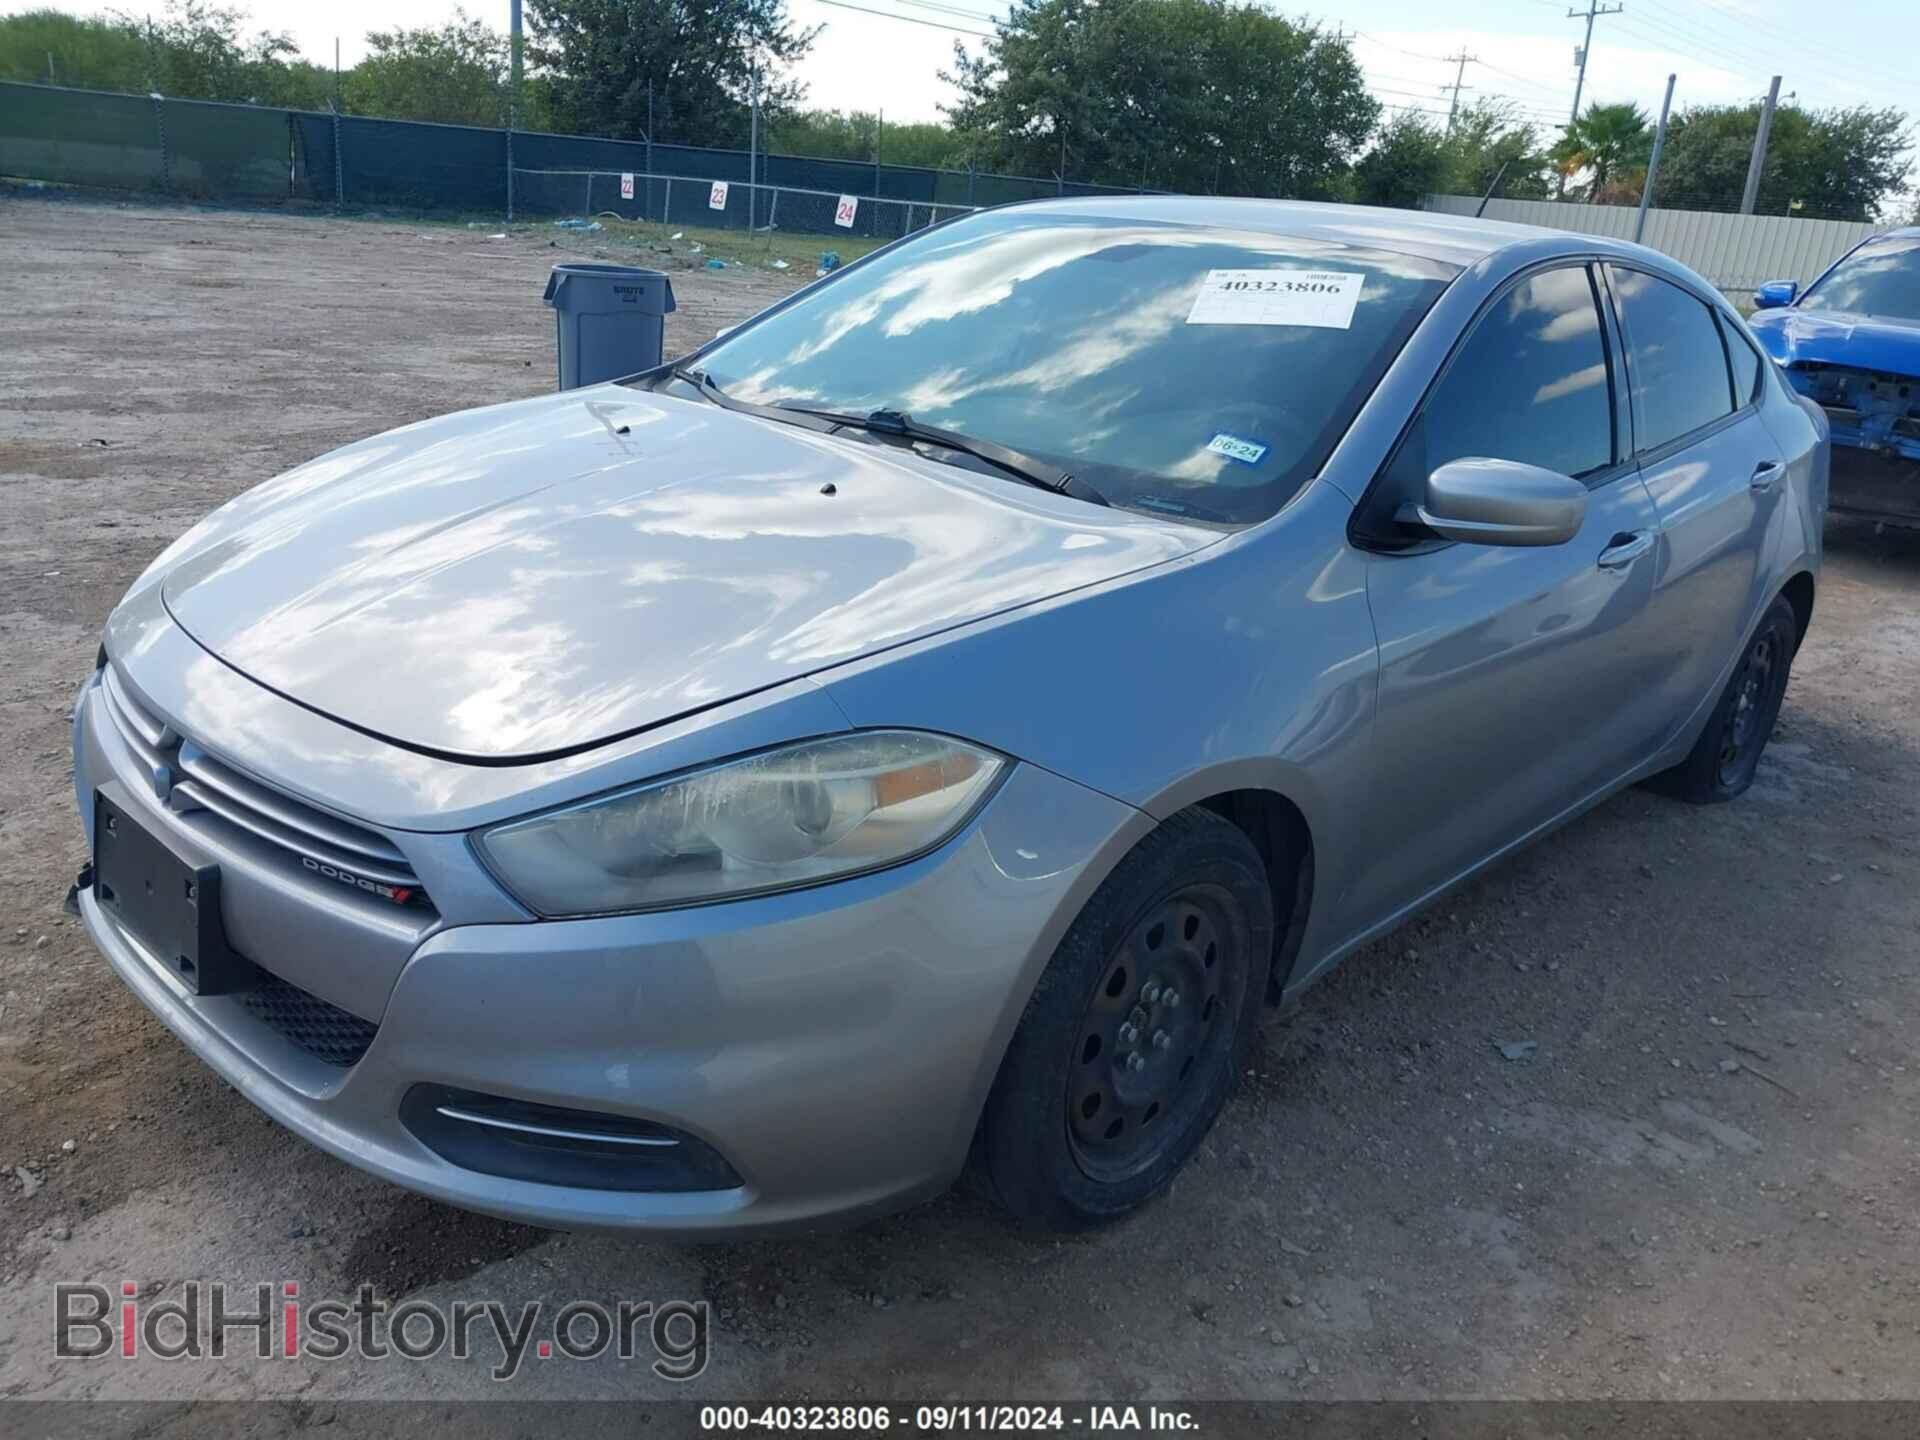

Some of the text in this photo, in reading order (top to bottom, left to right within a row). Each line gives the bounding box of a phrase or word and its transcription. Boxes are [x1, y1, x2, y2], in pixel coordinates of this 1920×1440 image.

[623, 180, 632, 194] 22
[712, 188, 725, 204] 23
[838, 202, 853, 221] 24
[1218, 281, 1341, 294] 40323806
[302, 857, 394, 898] DODGE
